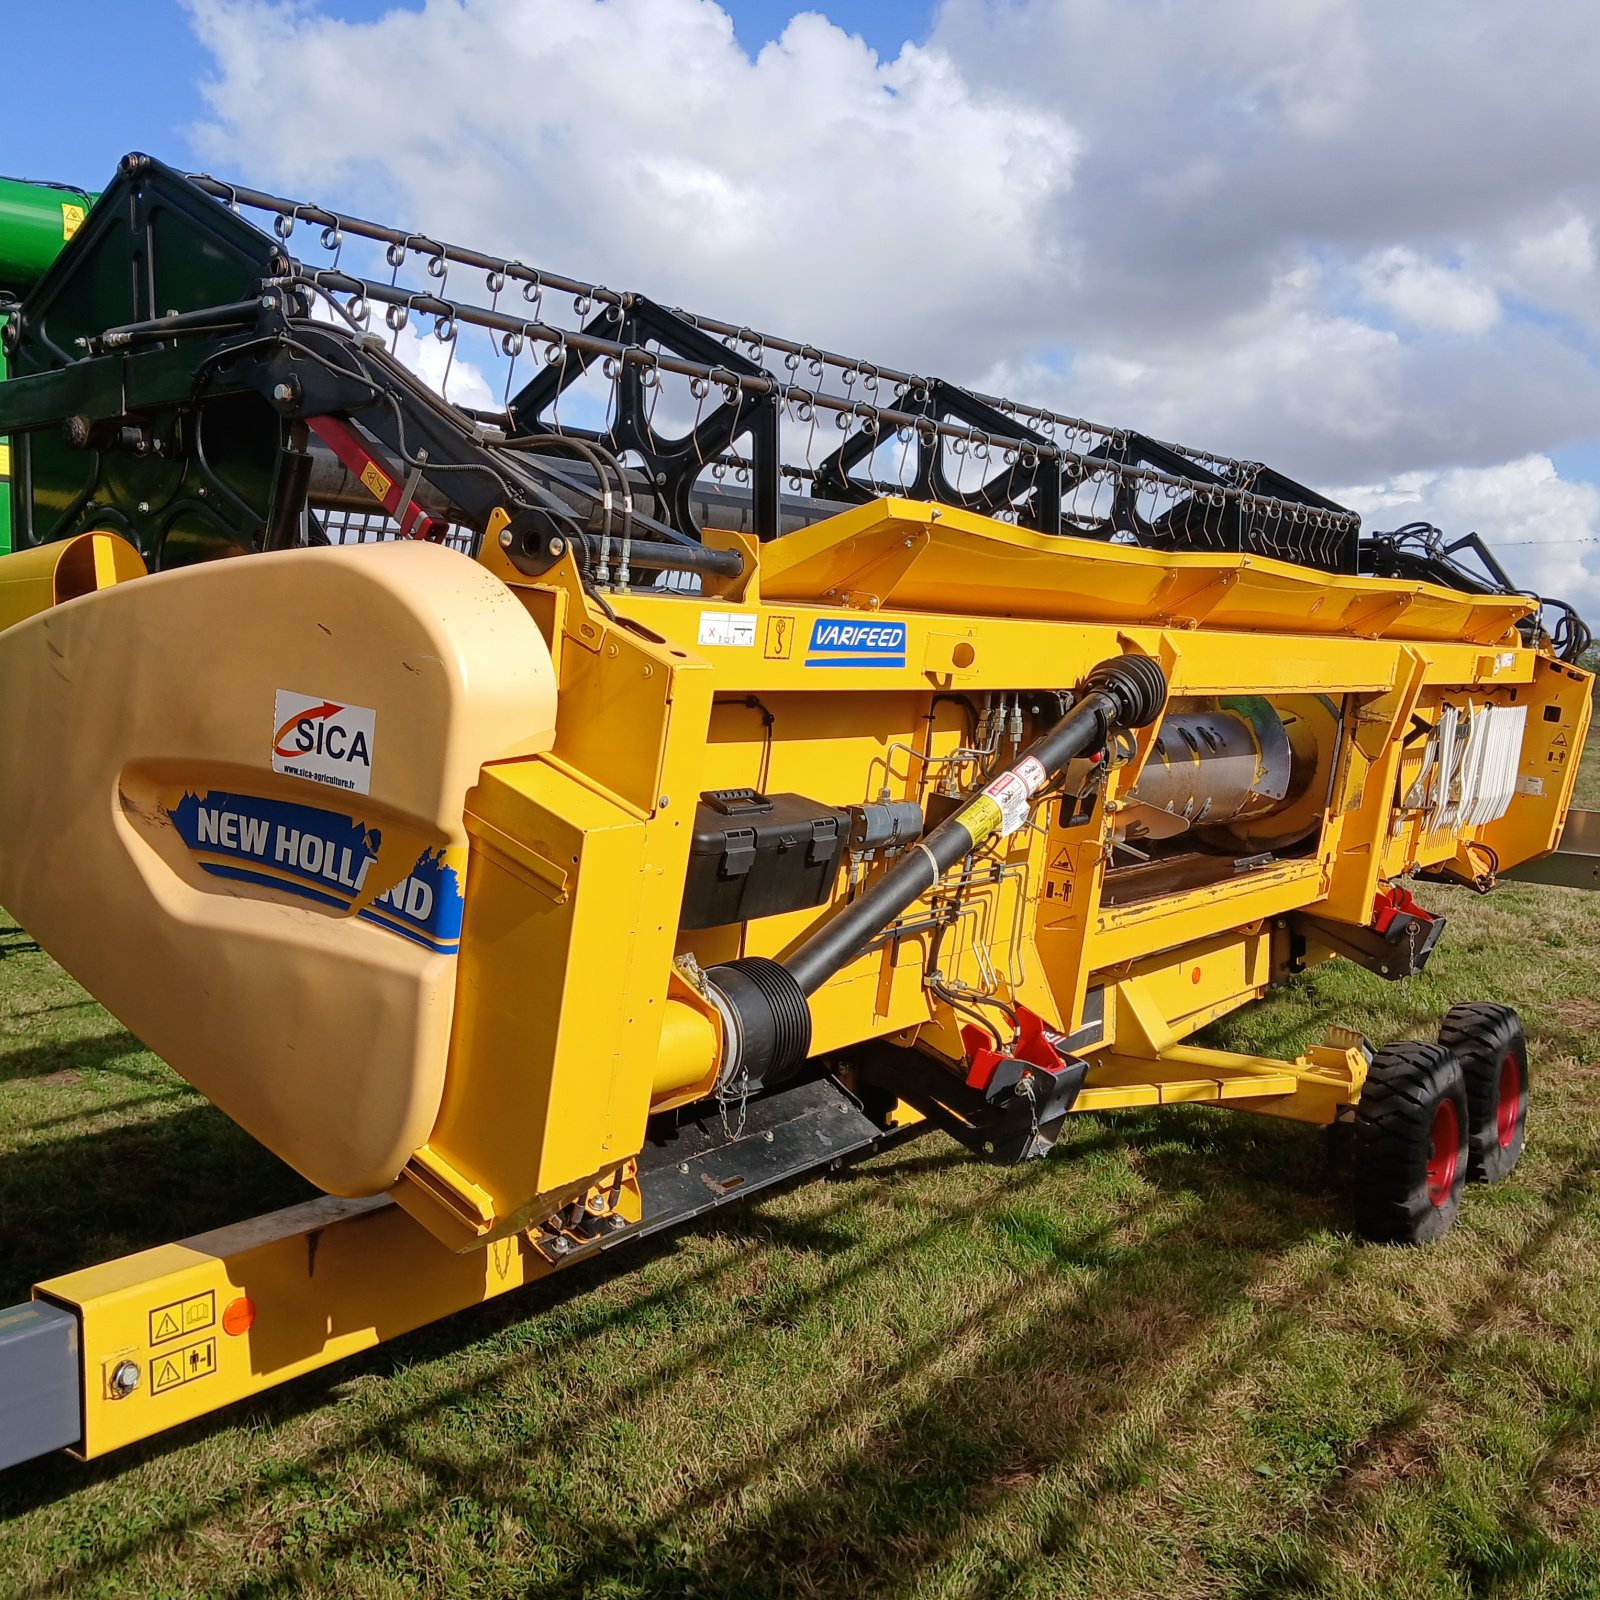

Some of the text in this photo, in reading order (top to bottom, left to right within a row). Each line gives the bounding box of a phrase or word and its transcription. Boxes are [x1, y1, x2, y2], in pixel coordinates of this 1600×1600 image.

[816, 625, 903, 648] VARIFEED
[295, 718, 370, 767] SICA
[284, 764, 355, 789] www.sica-agriculture.fr
[197, 807, 270, 856] NEW
